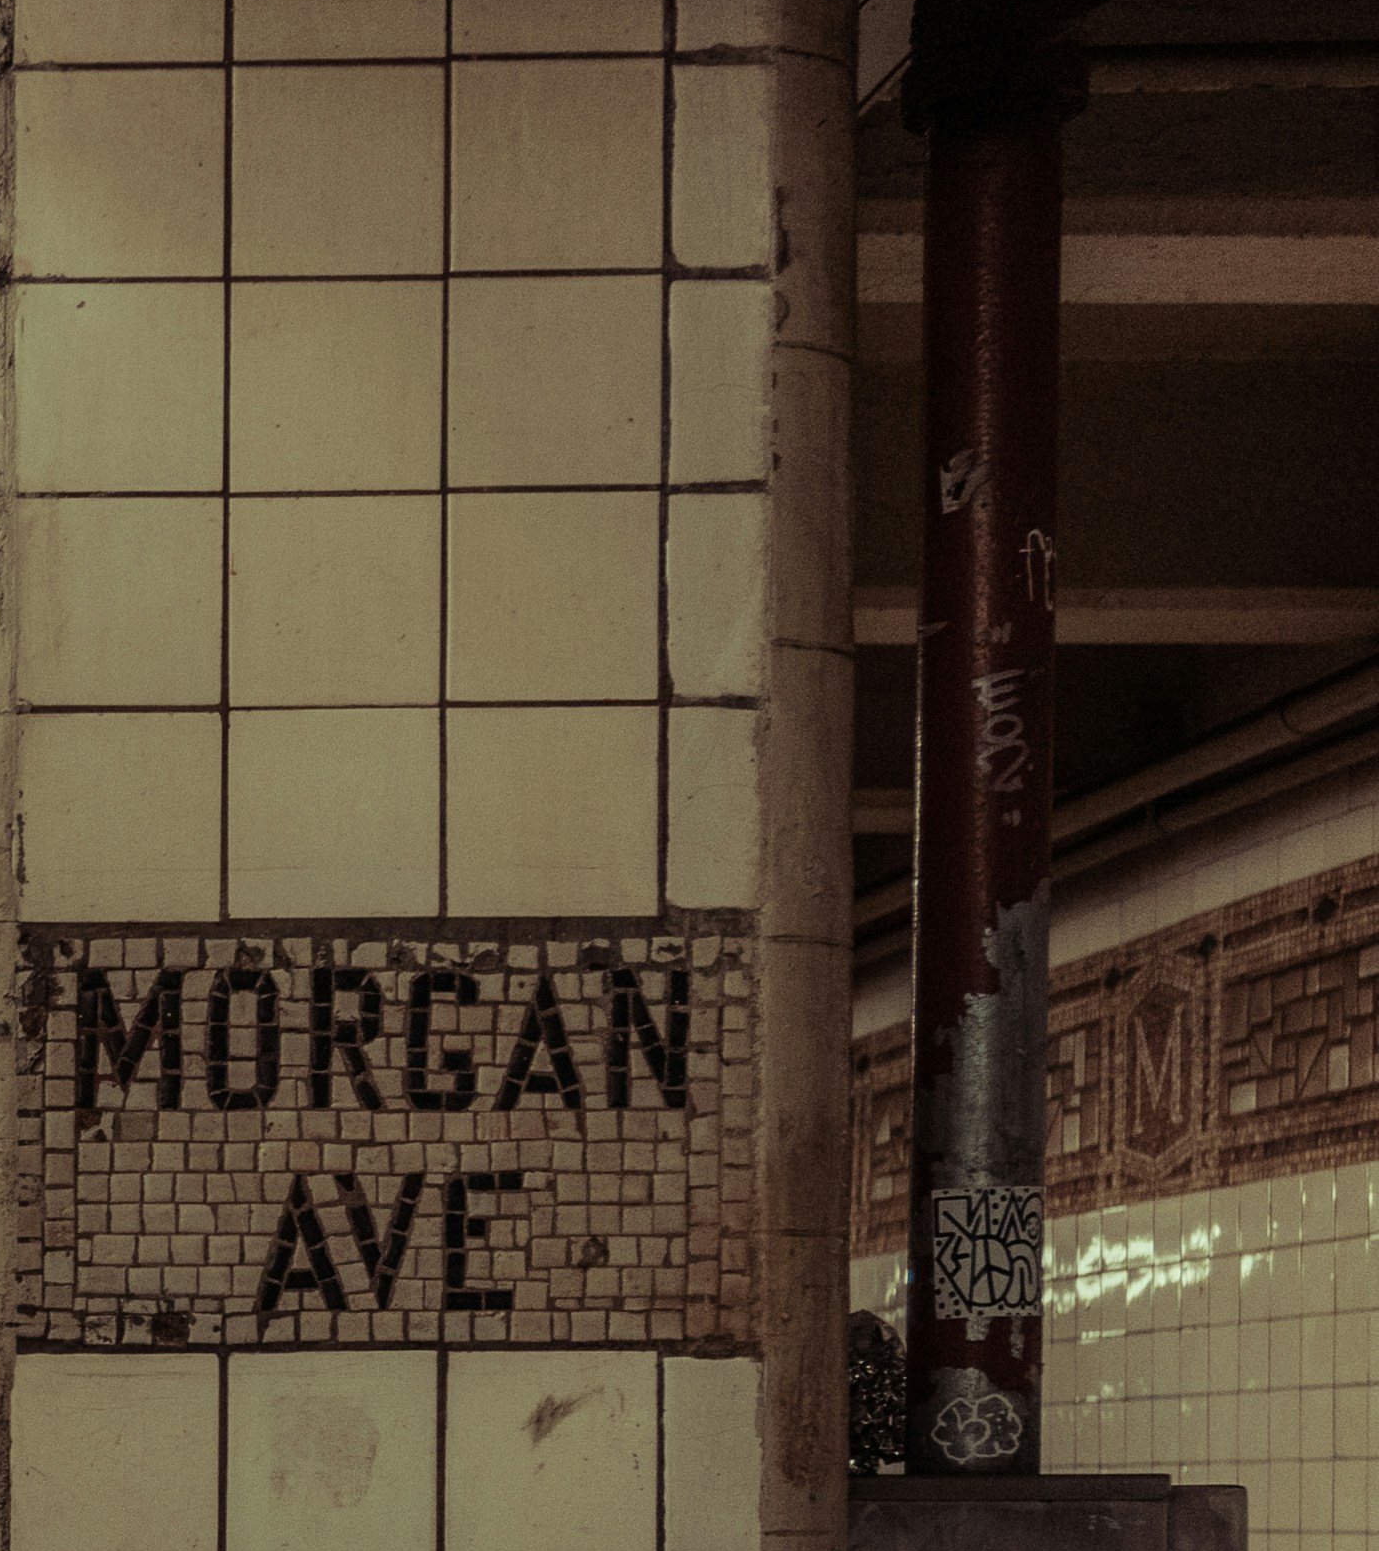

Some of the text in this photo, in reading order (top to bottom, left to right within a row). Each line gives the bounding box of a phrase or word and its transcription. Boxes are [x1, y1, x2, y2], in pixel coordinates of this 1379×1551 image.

[77, 968, 689, 1111] MORGAN
[1132, 1002, 1186, 1137] M
[258, 1172, 524, 1312] AVE
